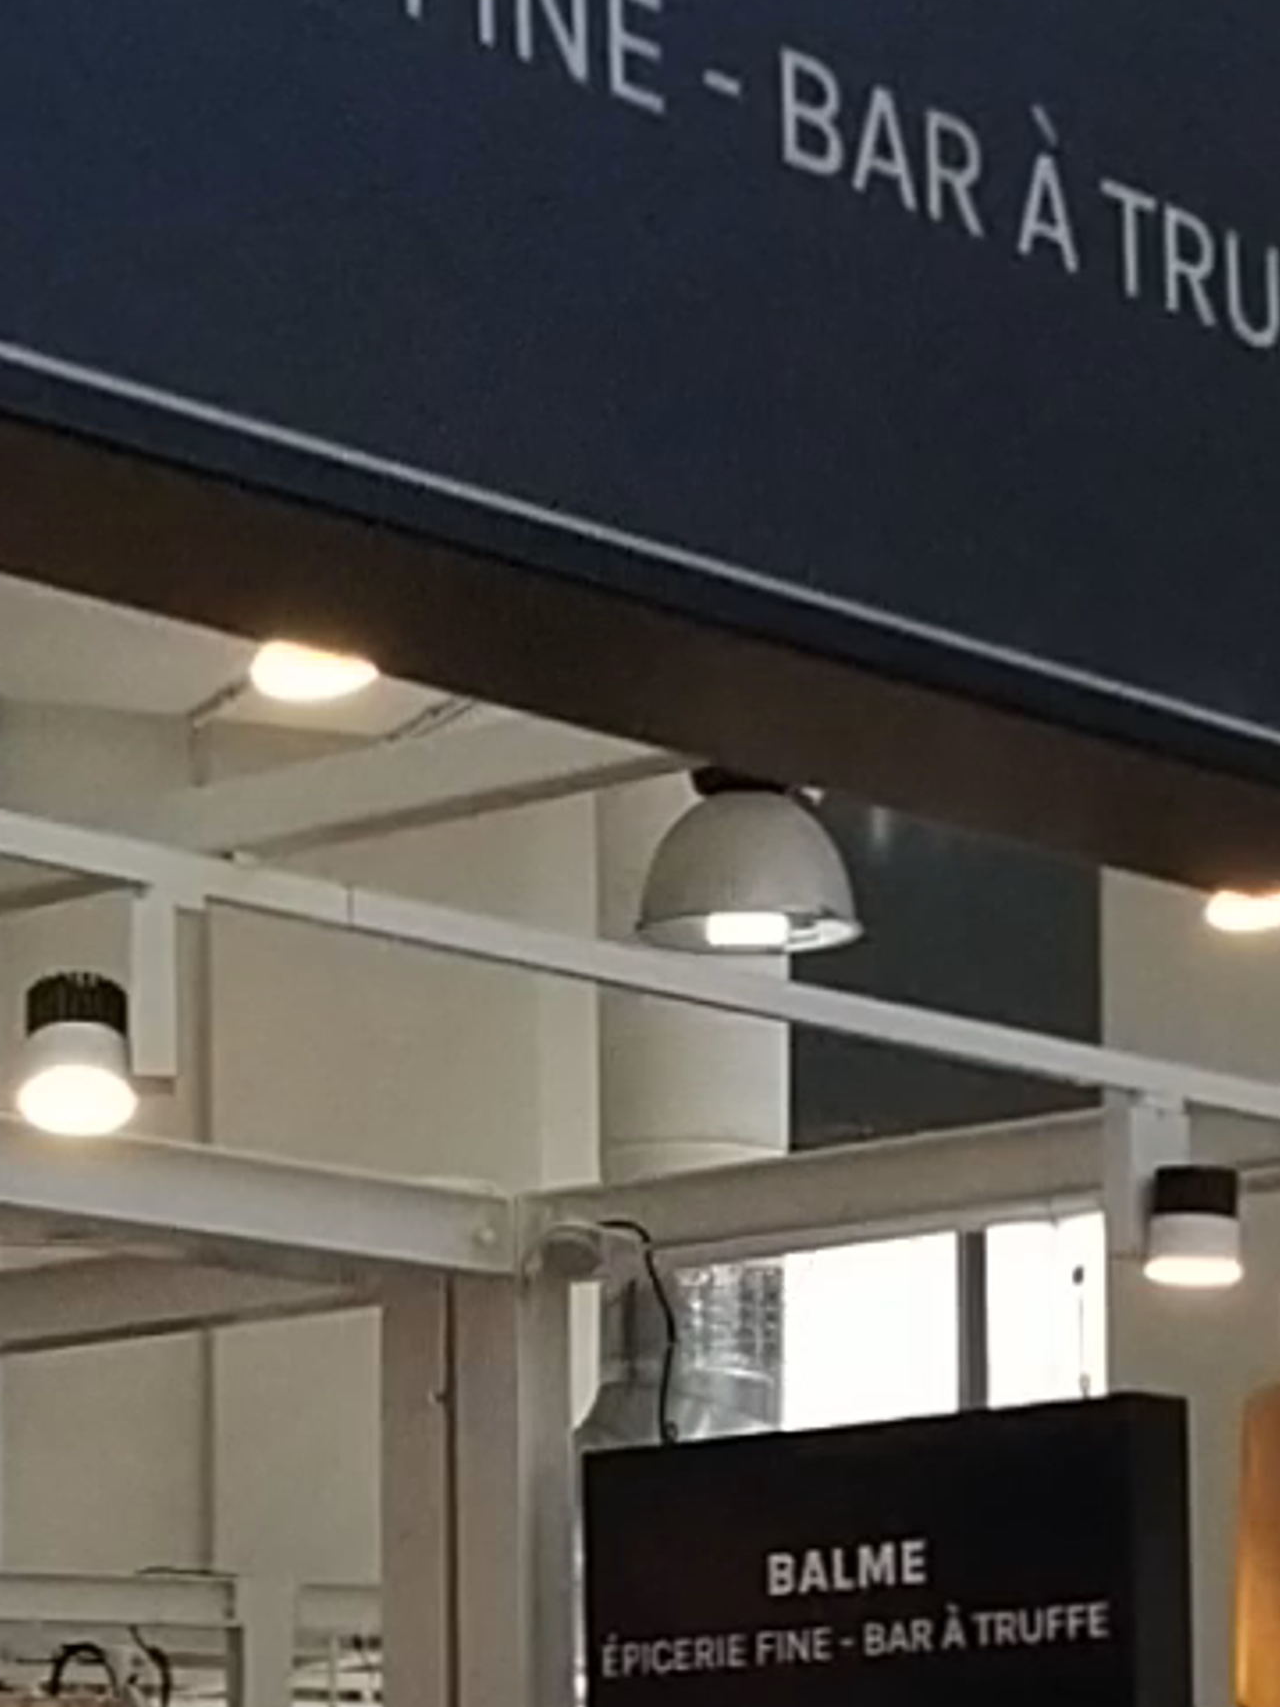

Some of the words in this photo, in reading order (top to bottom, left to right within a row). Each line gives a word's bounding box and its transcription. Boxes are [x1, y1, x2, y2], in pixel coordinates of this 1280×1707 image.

[703, 69, 741, 97] -
[781, 48, 983, 236] BAR
[1018, 105, 1079, 273] À
[767, 1539, 927, 1596] BALME
[601, 1634, 745, 1678] ÉPICERIE
[755, 1626, 831, 1664] FINE
[863, 1618, 932, 1657] BAR
[941, 1604, 966, 1649] À
[974, 1601, 1108, 1646] TRUFFE
